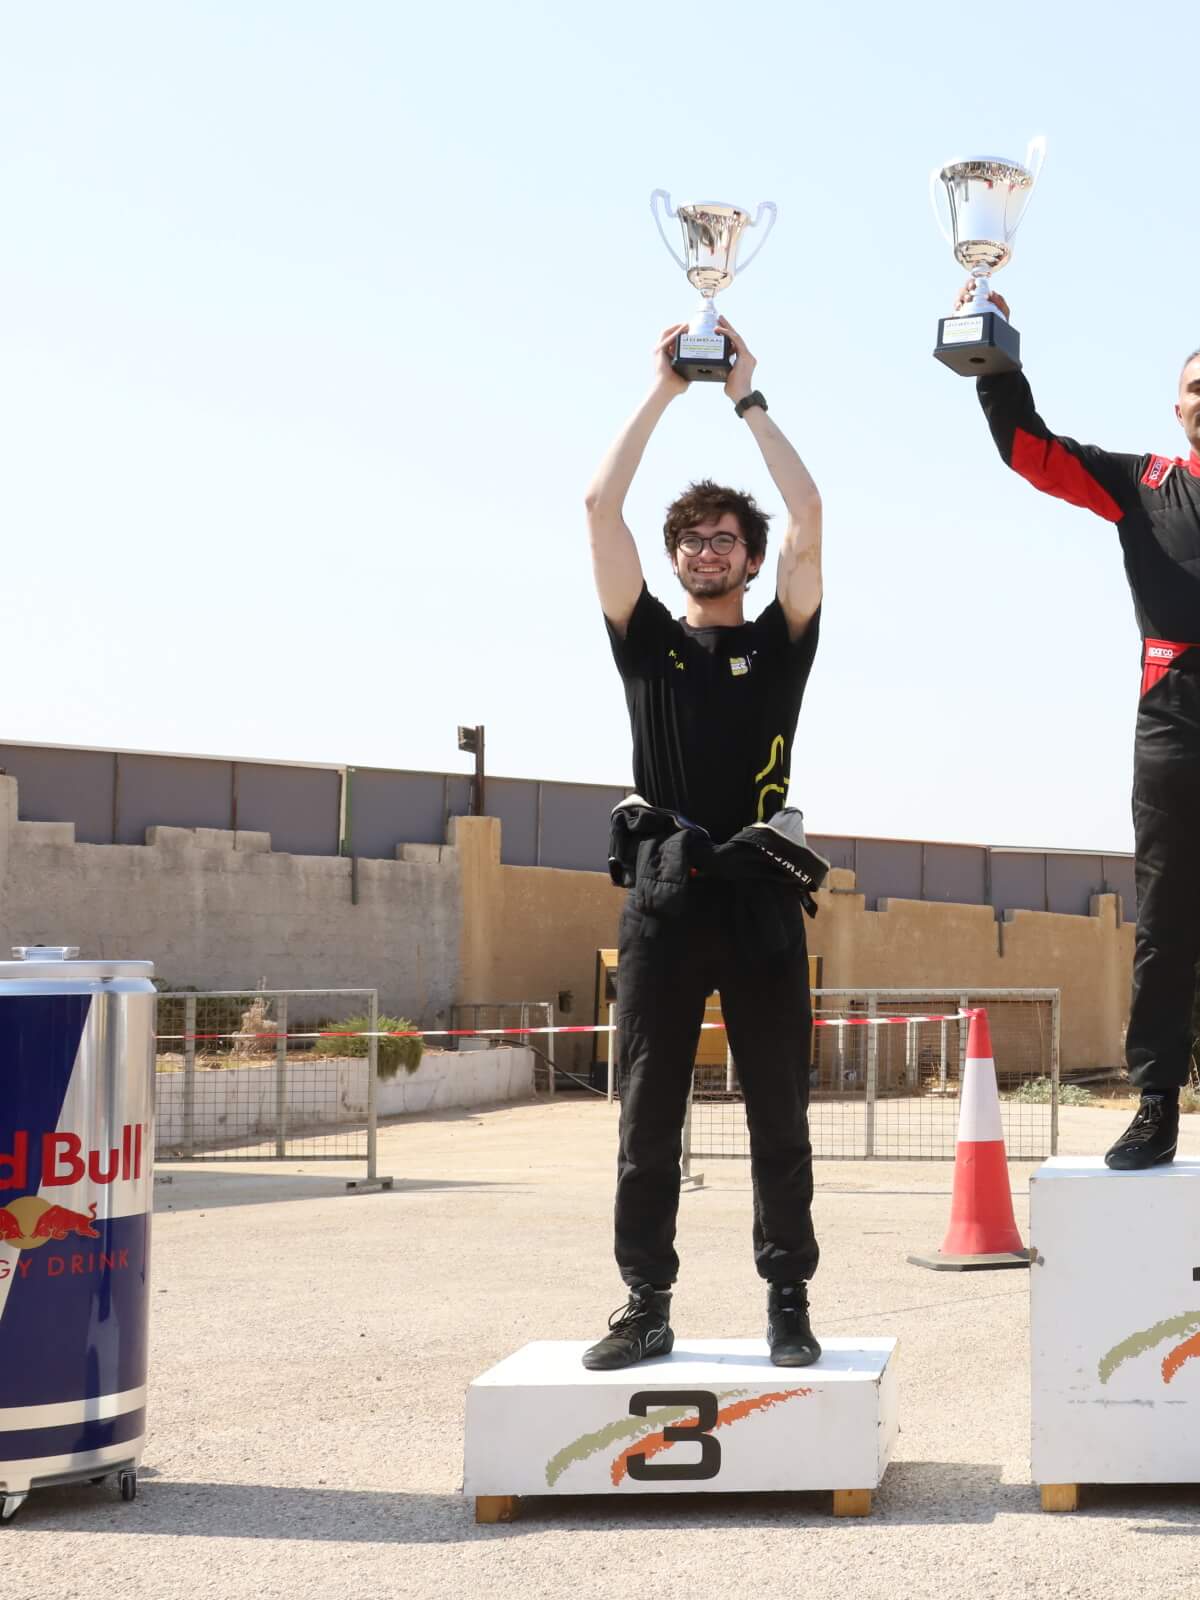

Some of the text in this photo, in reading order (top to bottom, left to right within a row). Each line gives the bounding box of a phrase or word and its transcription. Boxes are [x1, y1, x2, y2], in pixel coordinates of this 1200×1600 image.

[42, 1124, 142, 1187] Bull
[47, 1248, 129, 1277] DRINK
[626, 1390, 722, 1481] 3
